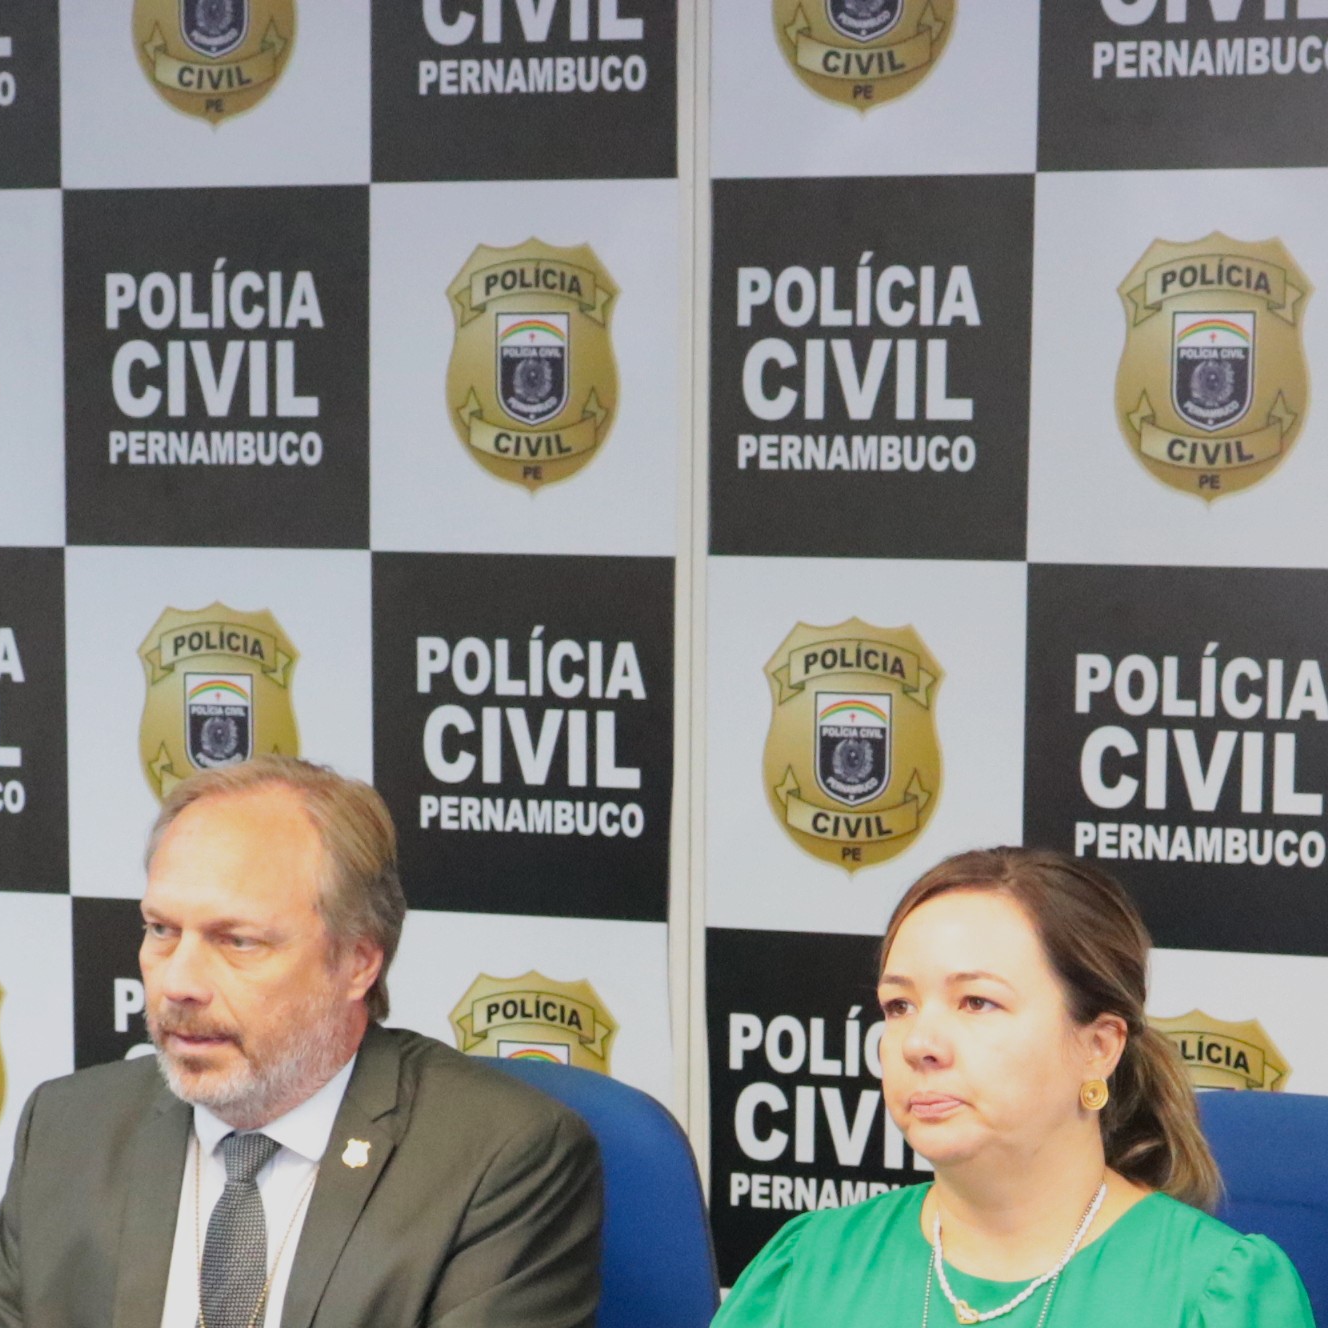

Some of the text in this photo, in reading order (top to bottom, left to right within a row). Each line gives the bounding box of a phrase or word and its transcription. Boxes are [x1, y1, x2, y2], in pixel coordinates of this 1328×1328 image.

[177, 65, 251, 91] CIVIL
[419, 55, 647, 95] PERNAMBUCO
[822, 50, 905, 76] CIVIL
[205, 98, 224, 113] PE
[852, 85, 872, 100] PE
[485, 268, 582, 299] POLÍCIA
[738, 251, 980, 327] POLÍCIA
[1161, 258, 1271, 295] POLÍCIA
[106, 258, 323, 329] POLÍCIA
[501, 345, 561, 359] POLÍCIA CIVIL
[1178, 346, 1245, 361] POLÍCIA CIVIL
[112, 340, 318, 417] CIVIL
[743, 338, 973, 420] CIVIL
[109, 431, 322, 465] PERNAMBUCO
[494, 432, 572, 457] CIVIL
[738, 435, 975, 472] PERNAMBUCO
[1166, 438, 1254, 466] CIVIL
[522, 466, 542, 480] PE
[1198, 474, 1220, 489] PE
[173, 630, 264, 660] POLÍCIA
[417, 626, 646, 699] POLÍCIA
[804, 647, 905, 679] POLÍCIA
[424, 705, 640, 788] CIVIL
[822, 727, 882, 739] POLÍCIA CIVIL
[1081, 726, 1323, 815] CIVIL
[420, 795, 644, 837] PERNAMBUCO
[811, 811, 892, 838] CIVIL
[841, 847, 860, 861] PE
[1075, 822, 1325, 867] PERNAMBUCO
[487, 999, 582, 1031] POLÍCIA
[1180, 1037, 1251, 1073] LÍCIA
[735, 1082, 934, 1172] CIVI
